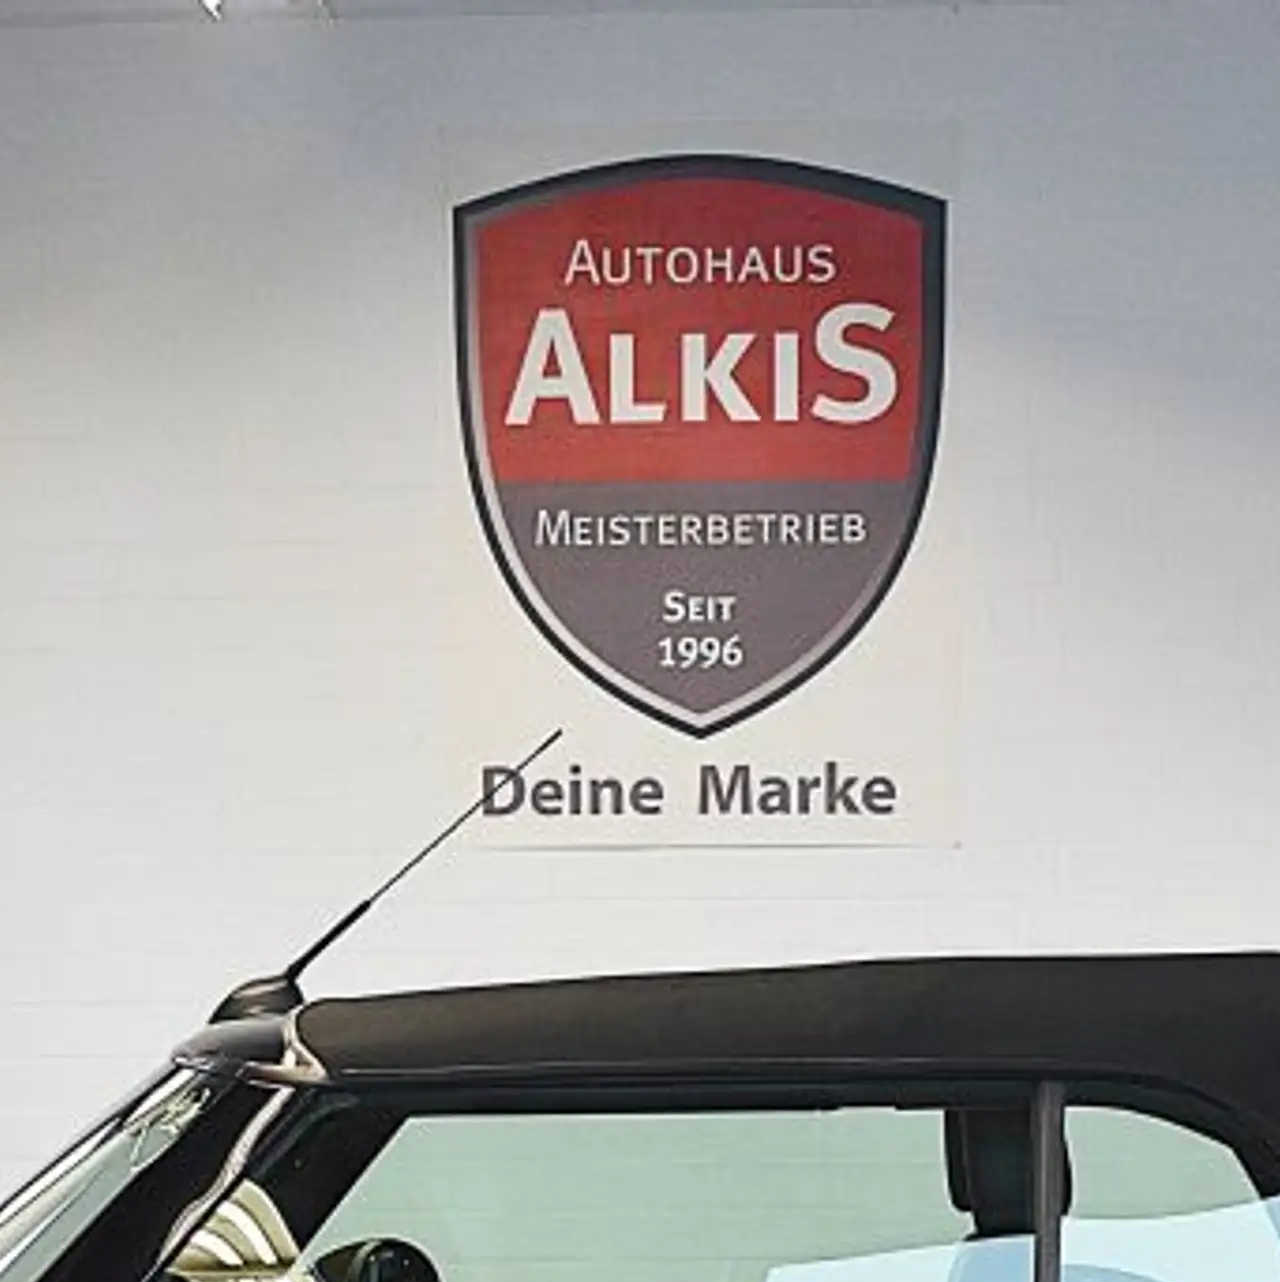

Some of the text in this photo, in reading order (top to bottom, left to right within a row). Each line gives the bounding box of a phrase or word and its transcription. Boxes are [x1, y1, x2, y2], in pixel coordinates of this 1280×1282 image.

[563, 237, 837, 287] AUTOHAUS
[534, 509, 868, 548] MEISTERBETRIEB
[657, 635, 744, 669] 1996
[481, 762, 898, 816] Deine Marke
